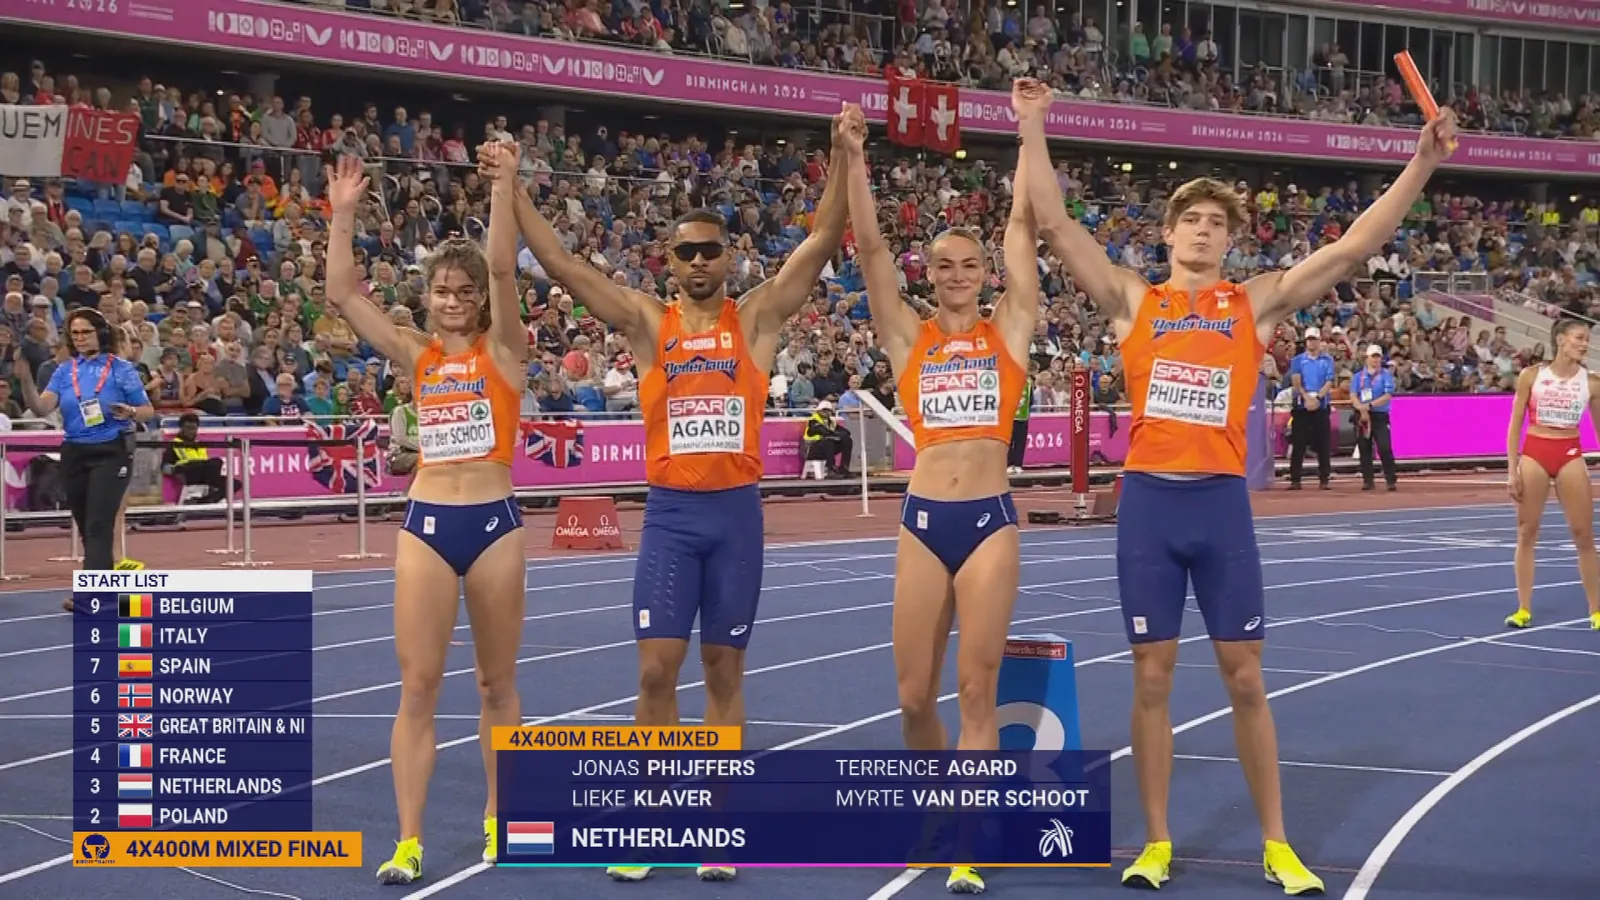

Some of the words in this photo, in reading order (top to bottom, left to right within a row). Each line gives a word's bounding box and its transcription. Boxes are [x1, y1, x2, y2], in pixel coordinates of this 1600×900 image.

[686, 75, 768, 95] BIRMINGHAM
[774, 84, 806, 99] 2026
[1045, 112, 1105, 128] IRMINGHAM
[1192, 125, 1254, 140] BIRMINGHAM
[921, 374, 977, 392] SPAR
[1155, 364, 1210, 384] SPAR
[922, 395, 997, 416] KLAVER
[1149, 383, 1226, 410] PHIJFFERS
[419, 405, 469, 425] SPAR
[670, 401, 724, 416] SPAR
[1074, 389, 1084, 435] OMEGA
[435, 429, 449, 446] der
[450, 423, 492, 444] SCHOOT
[673, 420, 741, 438] AGARD
[1026, 432, 1063, 449] 2026
[591, 444, 647, 462] BIRMI
[555, 526, 589, 538] OMEGA
[592, 526, 620, 538] OMEGA
